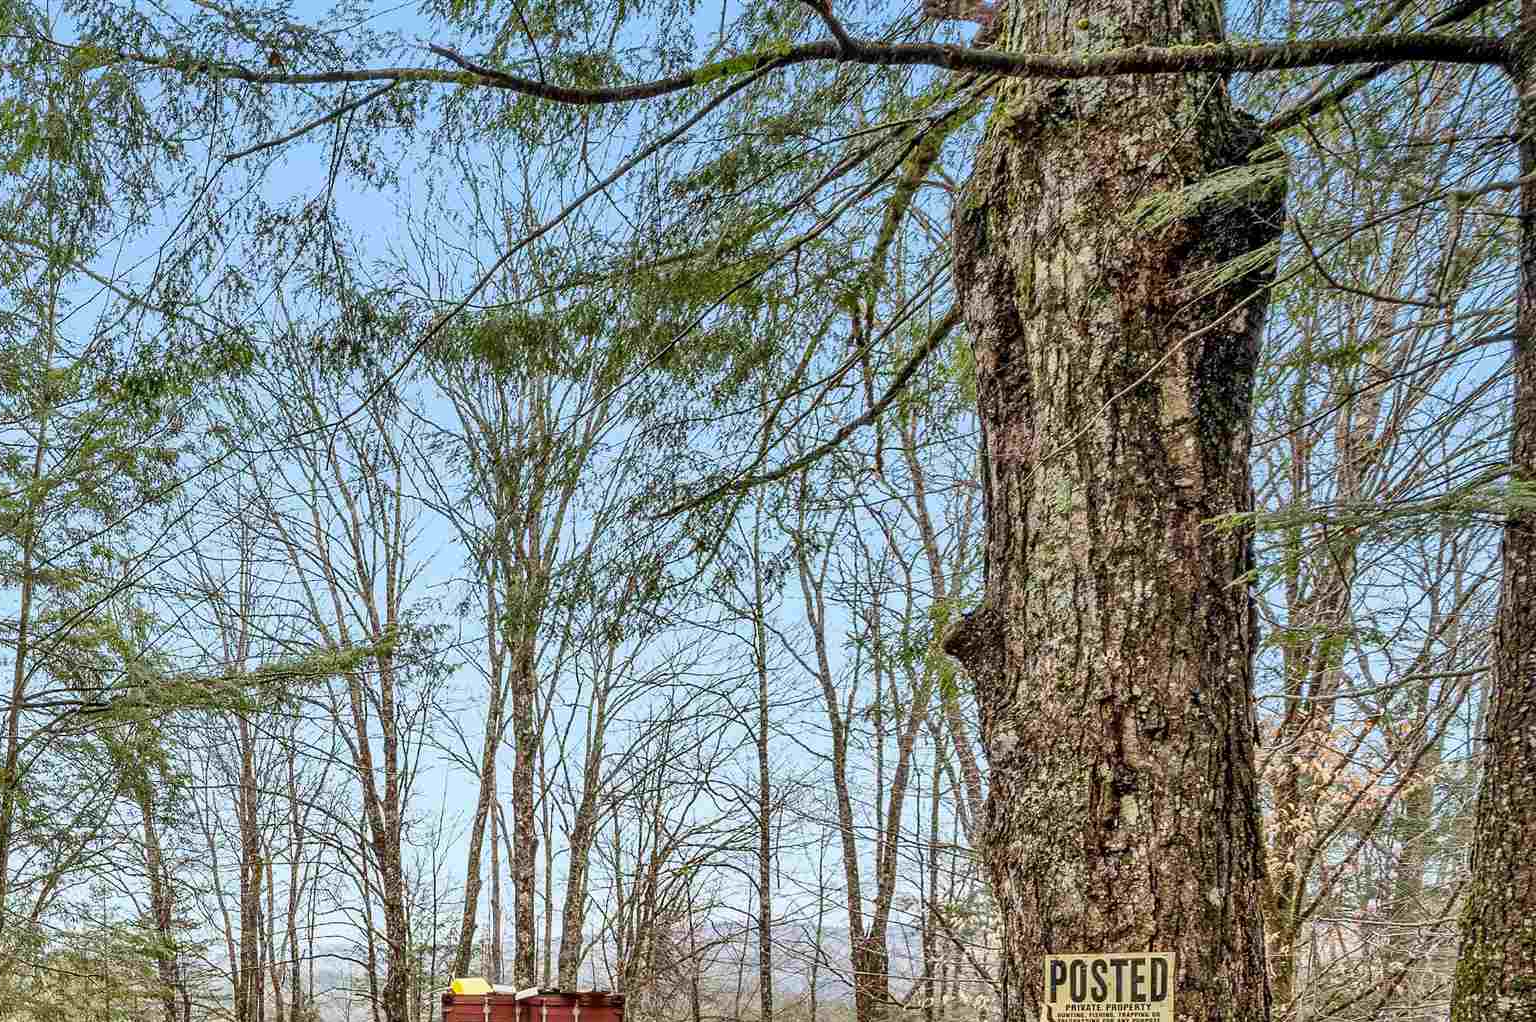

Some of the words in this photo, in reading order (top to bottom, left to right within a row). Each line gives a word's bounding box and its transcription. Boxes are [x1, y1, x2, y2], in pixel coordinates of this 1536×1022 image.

[1050, 957, 1168, 1003] POSTED
[1065, 1003, 1103, 1011] PRIVATE
[1106, 1003, 1152, 1011] PROPERTY
